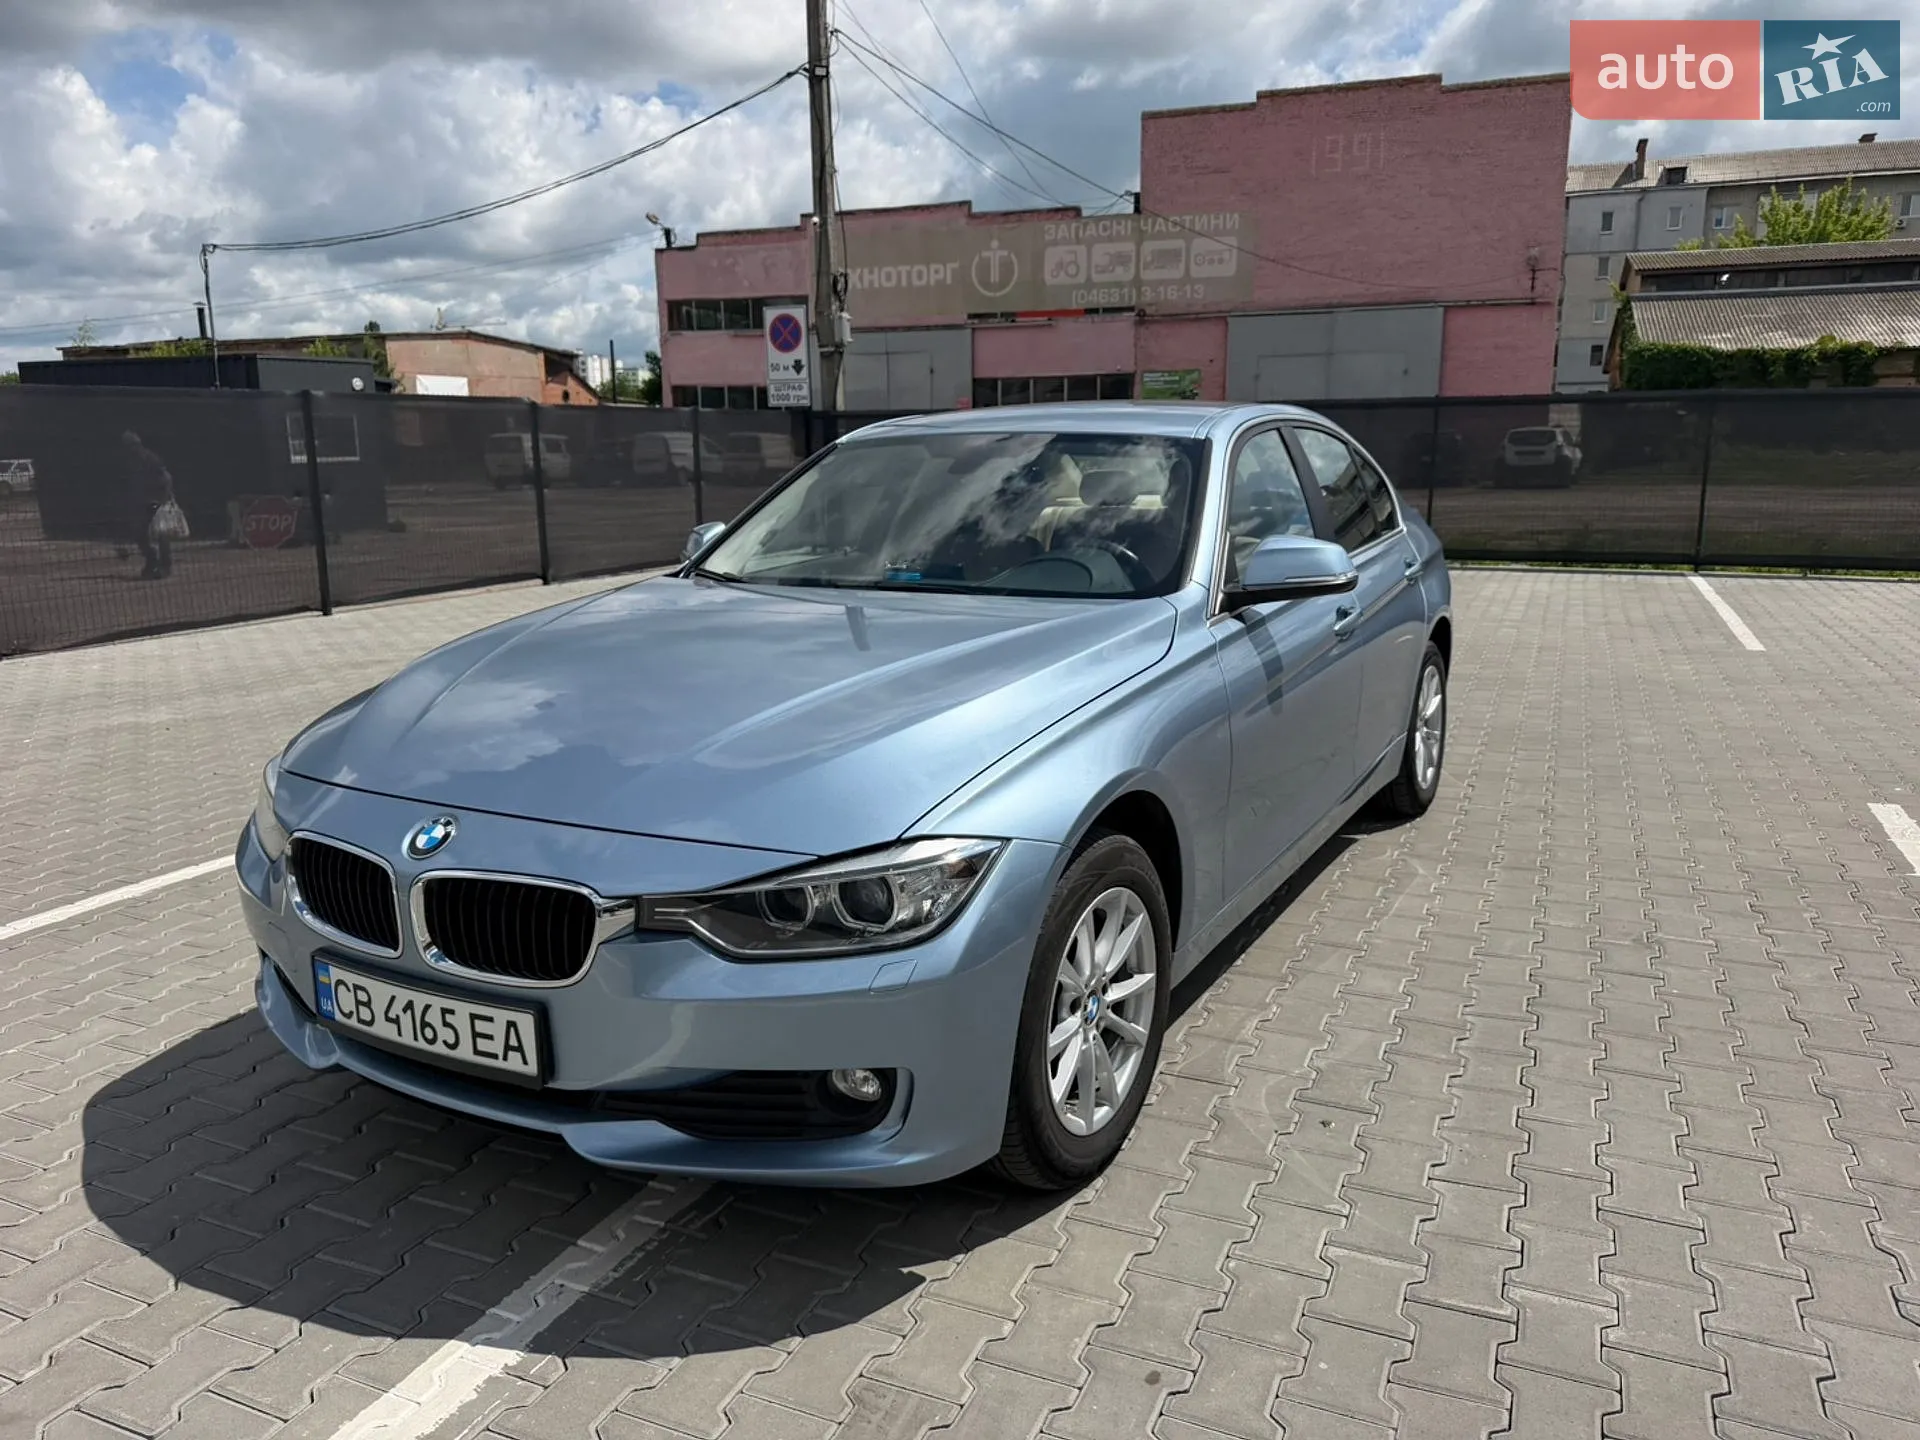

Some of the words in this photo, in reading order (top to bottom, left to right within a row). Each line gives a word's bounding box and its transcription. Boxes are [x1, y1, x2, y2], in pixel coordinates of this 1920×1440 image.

[1043, 219, 1133, 241] ЗАПАСНІ
[1140, 213, 1241, 234] ЧАСТИНИ
[1141, 284, 1206, 301] 3-16-13
[770, 362, 781, 372] 50
[245, 513, 292, 532] STOP
[321, 995, 333, 1013] UA
[334, 978, 376, 1027] CB
[384, 995, 460, 1050] 4165
[469, 1012, 529, 1066] EA
